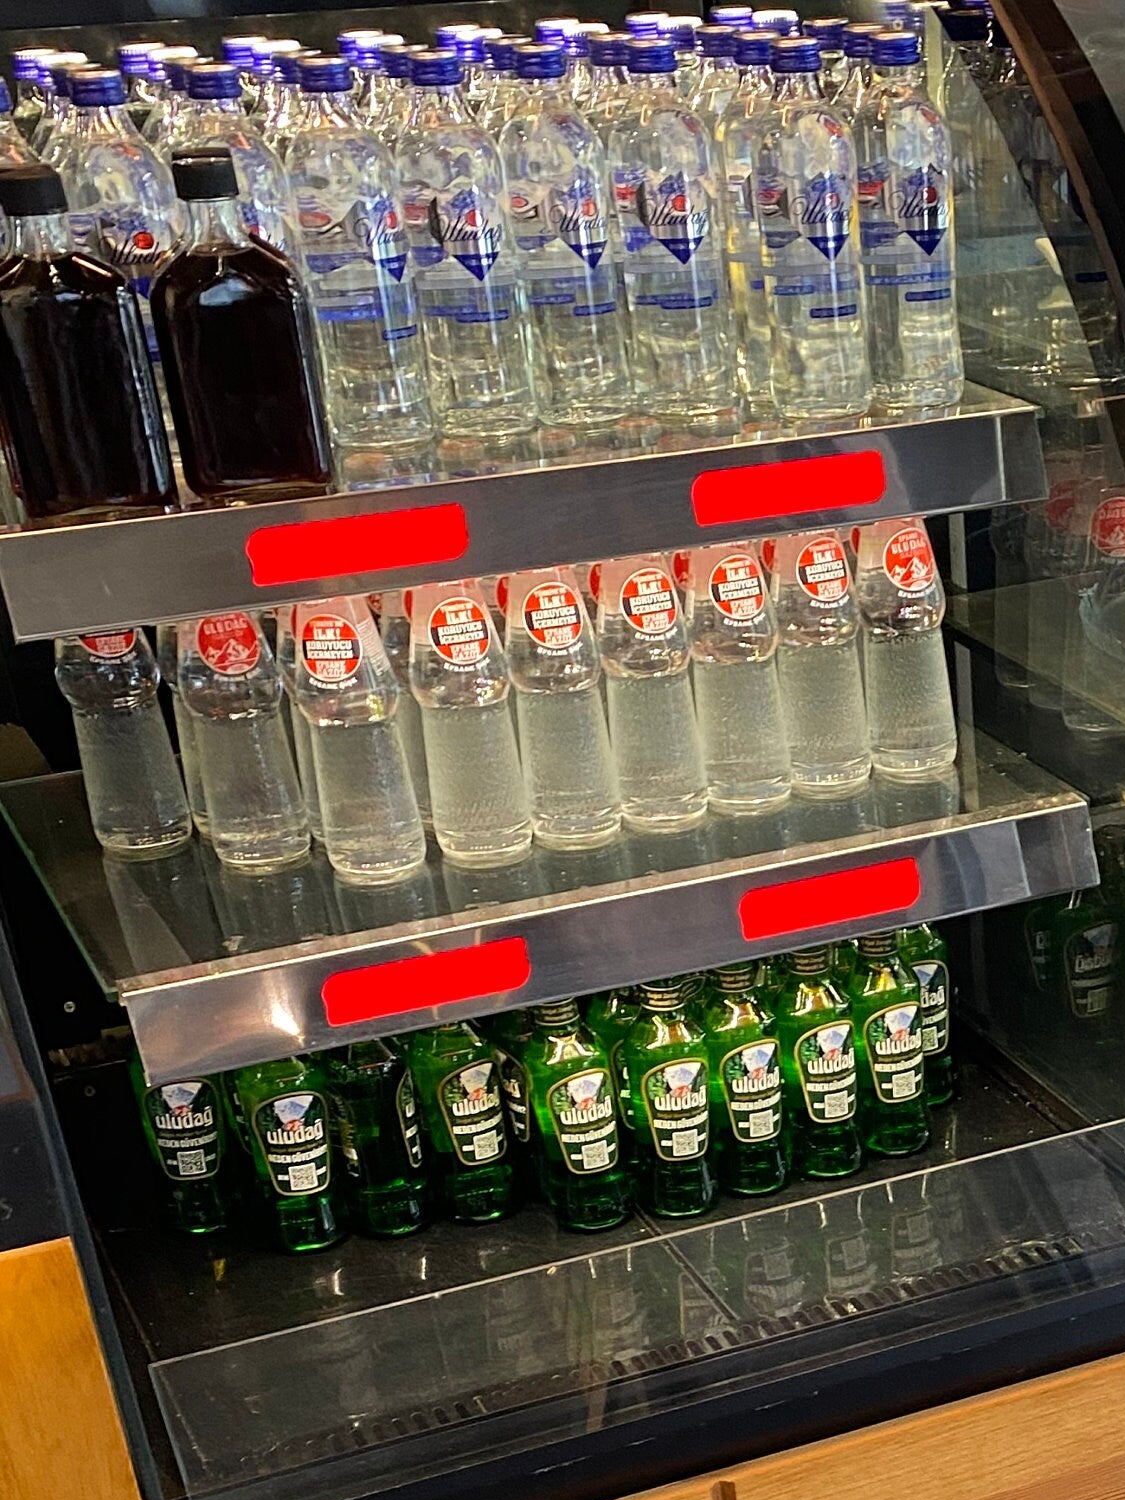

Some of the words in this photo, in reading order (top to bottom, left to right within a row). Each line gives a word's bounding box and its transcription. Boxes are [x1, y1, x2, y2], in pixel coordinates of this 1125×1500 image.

[921, 985, 945, 1008] dağ
[560, 1095, 613, 1125] uludağ
[654, 1085, 706, 1111] uludağ
[155, 1105, 213, 1129] uludağ
[267, 1118, 324, 1145] uludağ
